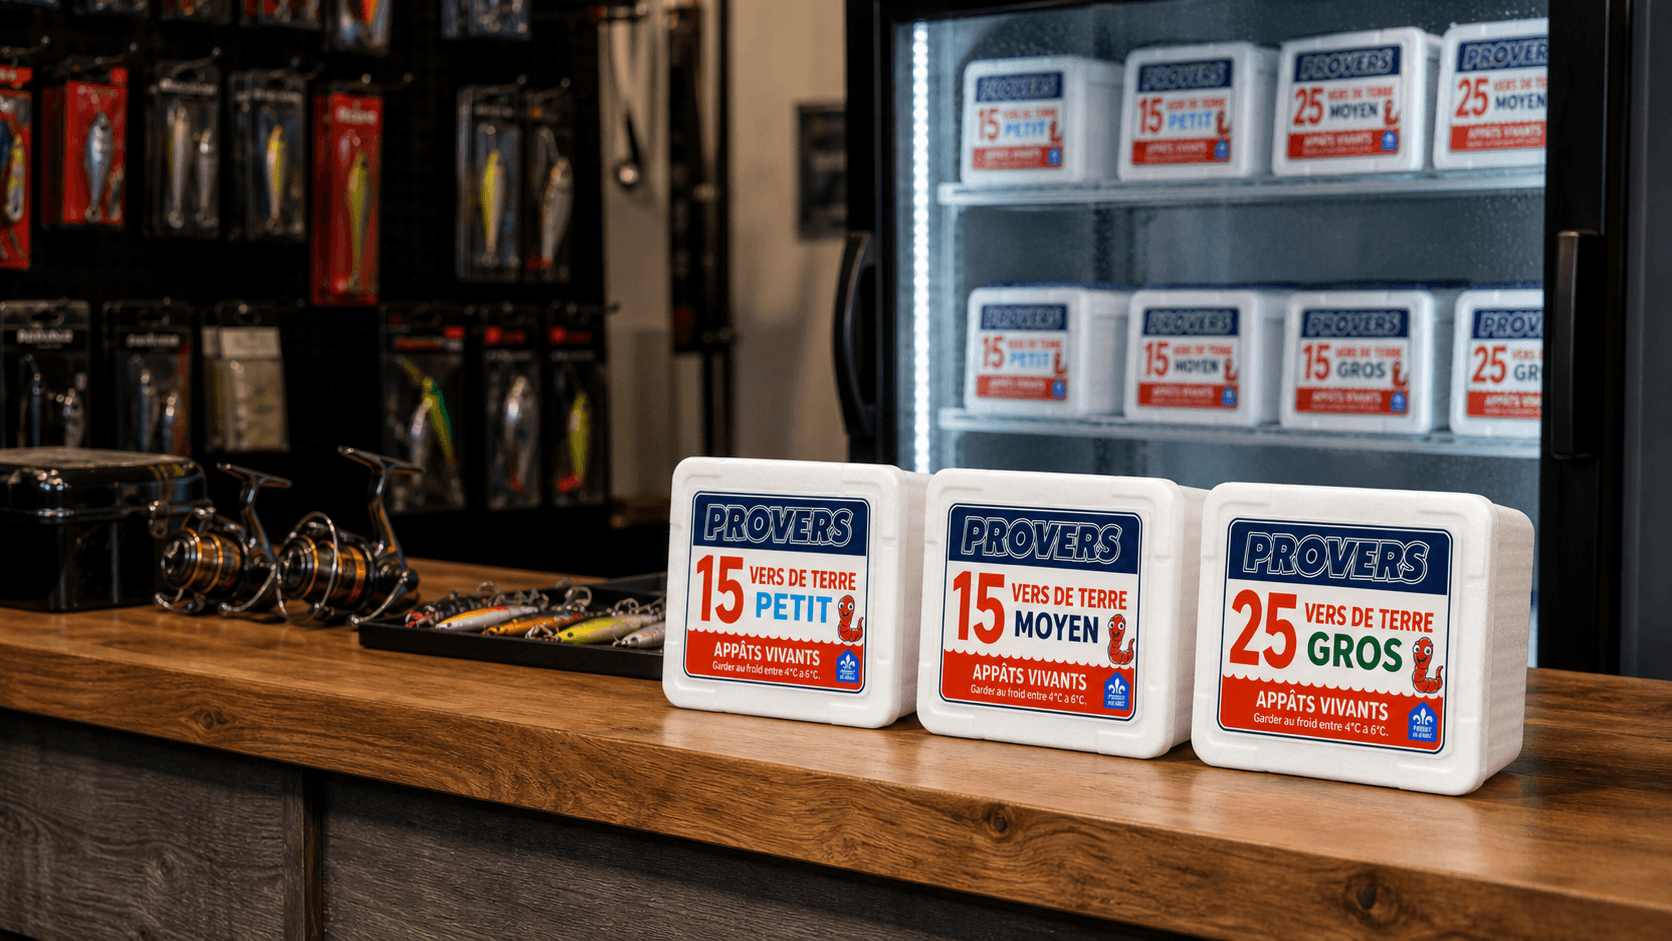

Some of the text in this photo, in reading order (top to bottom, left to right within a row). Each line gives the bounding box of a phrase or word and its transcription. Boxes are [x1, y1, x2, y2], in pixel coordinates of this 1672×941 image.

[1462, 39, 1547, 70] PROVER
[1293, 87, 1324, 126] 25
[1329, 102, 1378, 119] MOYEN
[1455, 77, 1489, 117] 25
[1495, 93, 1547, 111] MOYEN
[978, 108, 999, 141] 15
[1138, 97, 1163, 135] 15
[1480, 311, 1543, 336] PROV
[983, 336, 1004, 368] 15
[1144, 342, 1169, 376] 15
[1302, 343, 1331, 381] 15
[1472, 346, 1506, 383] 25
[1337, 361, 1386, 379] GROS
[1514, 363, 1541, 381] GR
[704, 503, 854, 547] PROVERS
[961, 515, 1123, 564] PROVERS
[1243, 532, 1430, 584] PROVERS
[696, 554, 744, 624] 15
[749, 565, 857, 591] VERS DE TERRE
[755, 591, 833, 624] PETIT
[953, 570, 1006, 645] 15
[1011, 582, 1128, 611] VERS DE TERRE
[1014, 610, 1099, 644] MOYEN
[1229, 589, 1298, 670] 25
[1304, 602, 1434, 634] VERS DE TERRE
[712, 660, 735, 671] Garder
[764, 666, 783, 676] entre
[714, 640, 820, 666] APPÂTS VIVANTS
[1307, 631, 1403, 673] GROS
[971, 684, 995, 695] Garder
[996, 688, 1006, 697] au
[1007, 687, 1026, 699] froid
[1027, 690, 1047, 701] entre
[972, 662, 1087, 691] APPÂTS VIVANTS
[1255, 689, 1389, 721] APPÂTS VIVANTS
[1253, 712, 1282, 725] Garder
[1284, 717, 1295, 726] au
[1296, 716, 1317, 728] froid
[1319, 720, 1343, 732] entre
